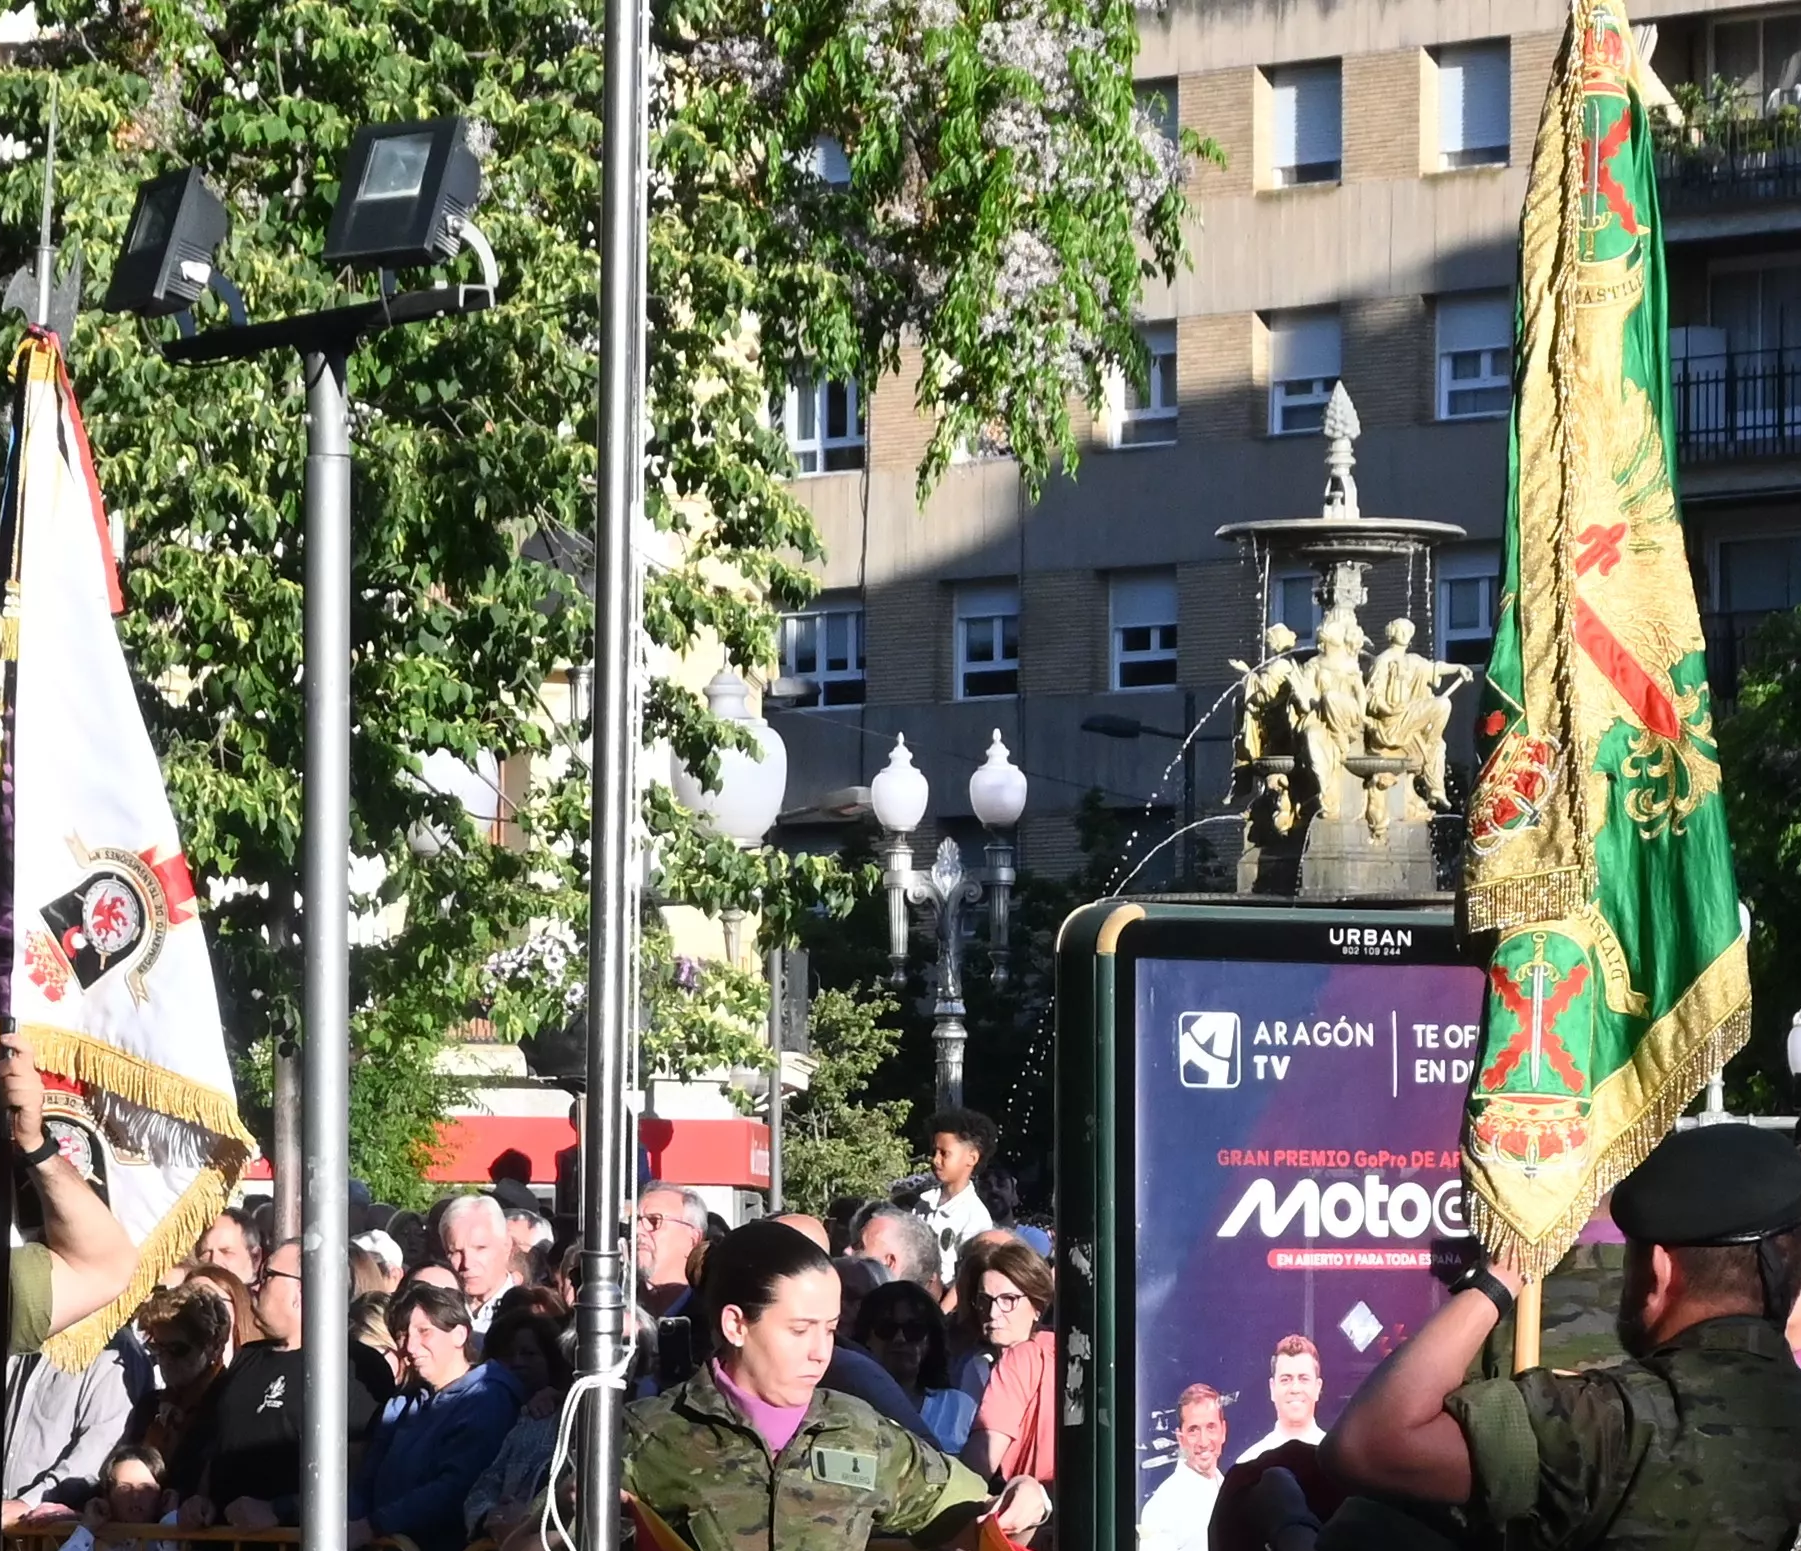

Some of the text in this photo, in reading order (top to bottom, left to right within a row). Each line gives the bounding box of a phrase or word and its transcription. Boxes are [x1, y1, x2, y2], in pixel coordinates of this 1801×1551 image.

[1330, 928, 1412, 947] URBAN
[1253, 1015, 1374, 1047] ARAGÓN
[1413, 1024, 1439, 1048] TE
[1253, 1055, 1291, 1081] TV
[1415, 1059, 1445, 1084] EN
[1217, 1150, 1269, 1167] GRAN
[1274, 1150, 1350, 1167] PREMIO
[1354, 1151, 1406, 1168] GoPro
[1412, 1151, 1435, 1167] DE
[1277, 1252, 1462, 1266] EN ABIERTO Y PARA TODA ESPAÑA
